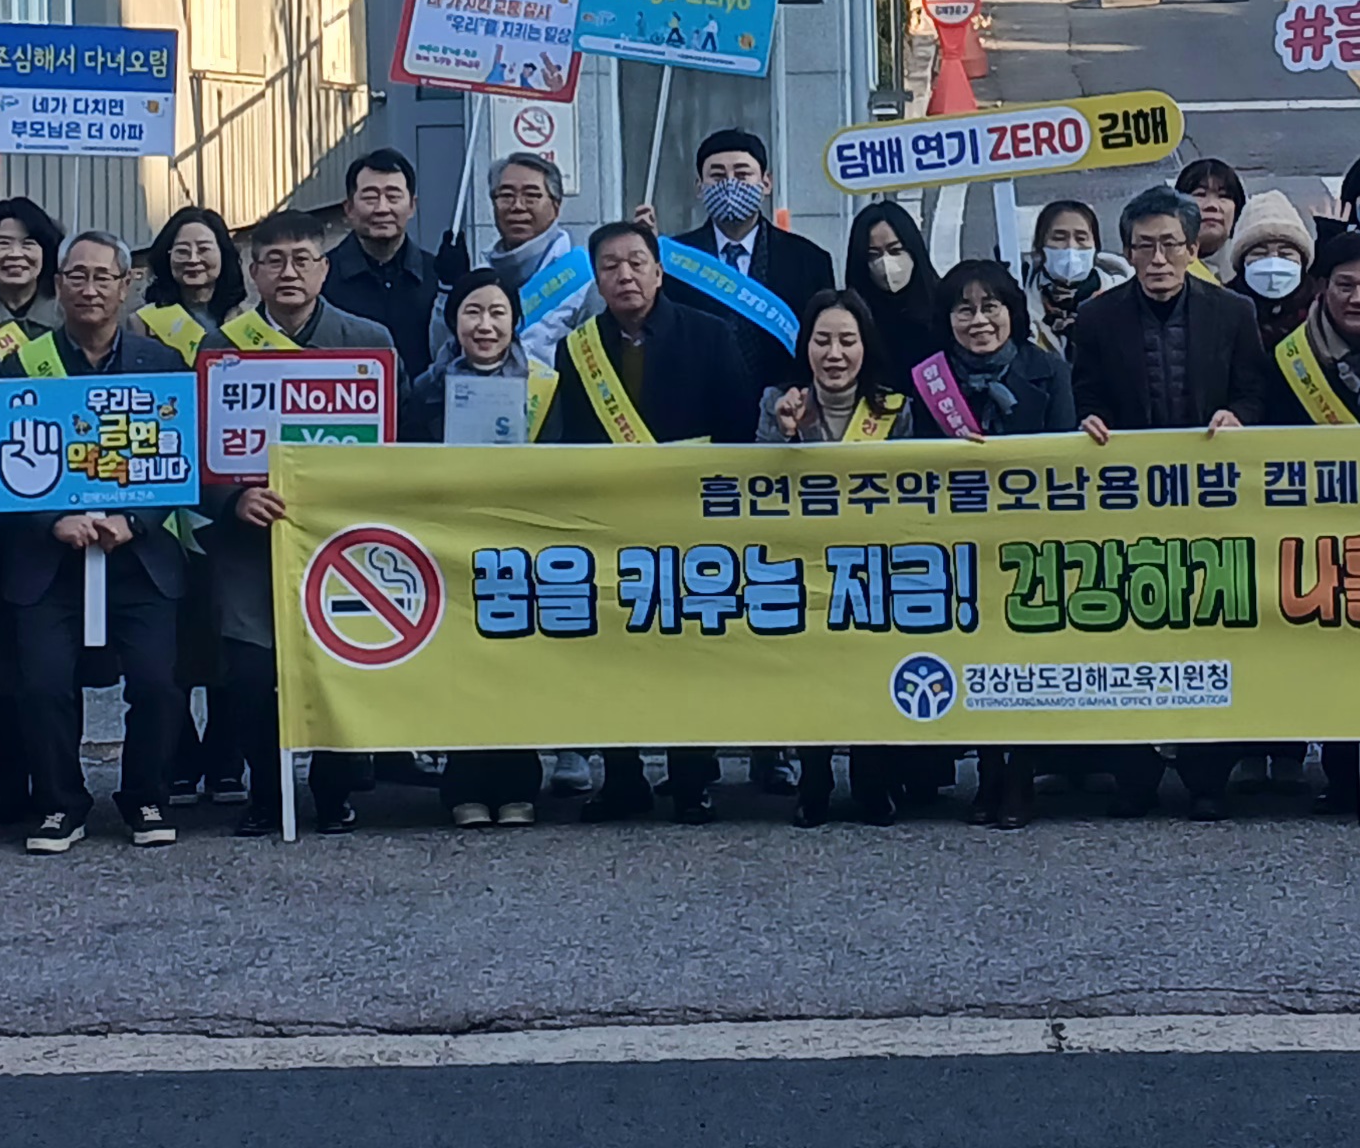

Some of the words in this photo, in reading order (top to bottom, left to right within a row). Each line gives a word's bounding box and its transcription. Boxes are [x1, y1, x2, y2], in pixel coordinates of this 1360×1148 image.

[500, 20, 543, 42] 지키는
[543, 26, 573, 46] 일상
[31, 95, 68, 116] 네가
[73, 97, 125, 117] 다치면
[10, 120, 82, 140] 부모님은
[87, 121, 104, 141] 더
[109, 122, 144, 142] 아파
[835, 136, 905, 180] 담배
[911, 128, 981, 170] 연기
[987, 117, 1084, 162] ZERO
[1098, 105, 1169, 151] 김해
[87, 387, 154, 413] 우리는
[222, 383, 276, 412] 뛰기
[285, 382, 377, 413] No,No
[98, 413, 180, 455] 금연을
[67, 442, 190, 486] 약속합니다
[698, 458, 1242, 519] 흡연음주약물오남용예방
[472, 545, 599, 639] 꿈을
[616, 543, 807, 637] 키우는
[826, 541, 980, 634] 지금!
[998, 535, 1258, 632] 건강하게
[965, 662, 1229, 694] 경상남도김해교육지원청
